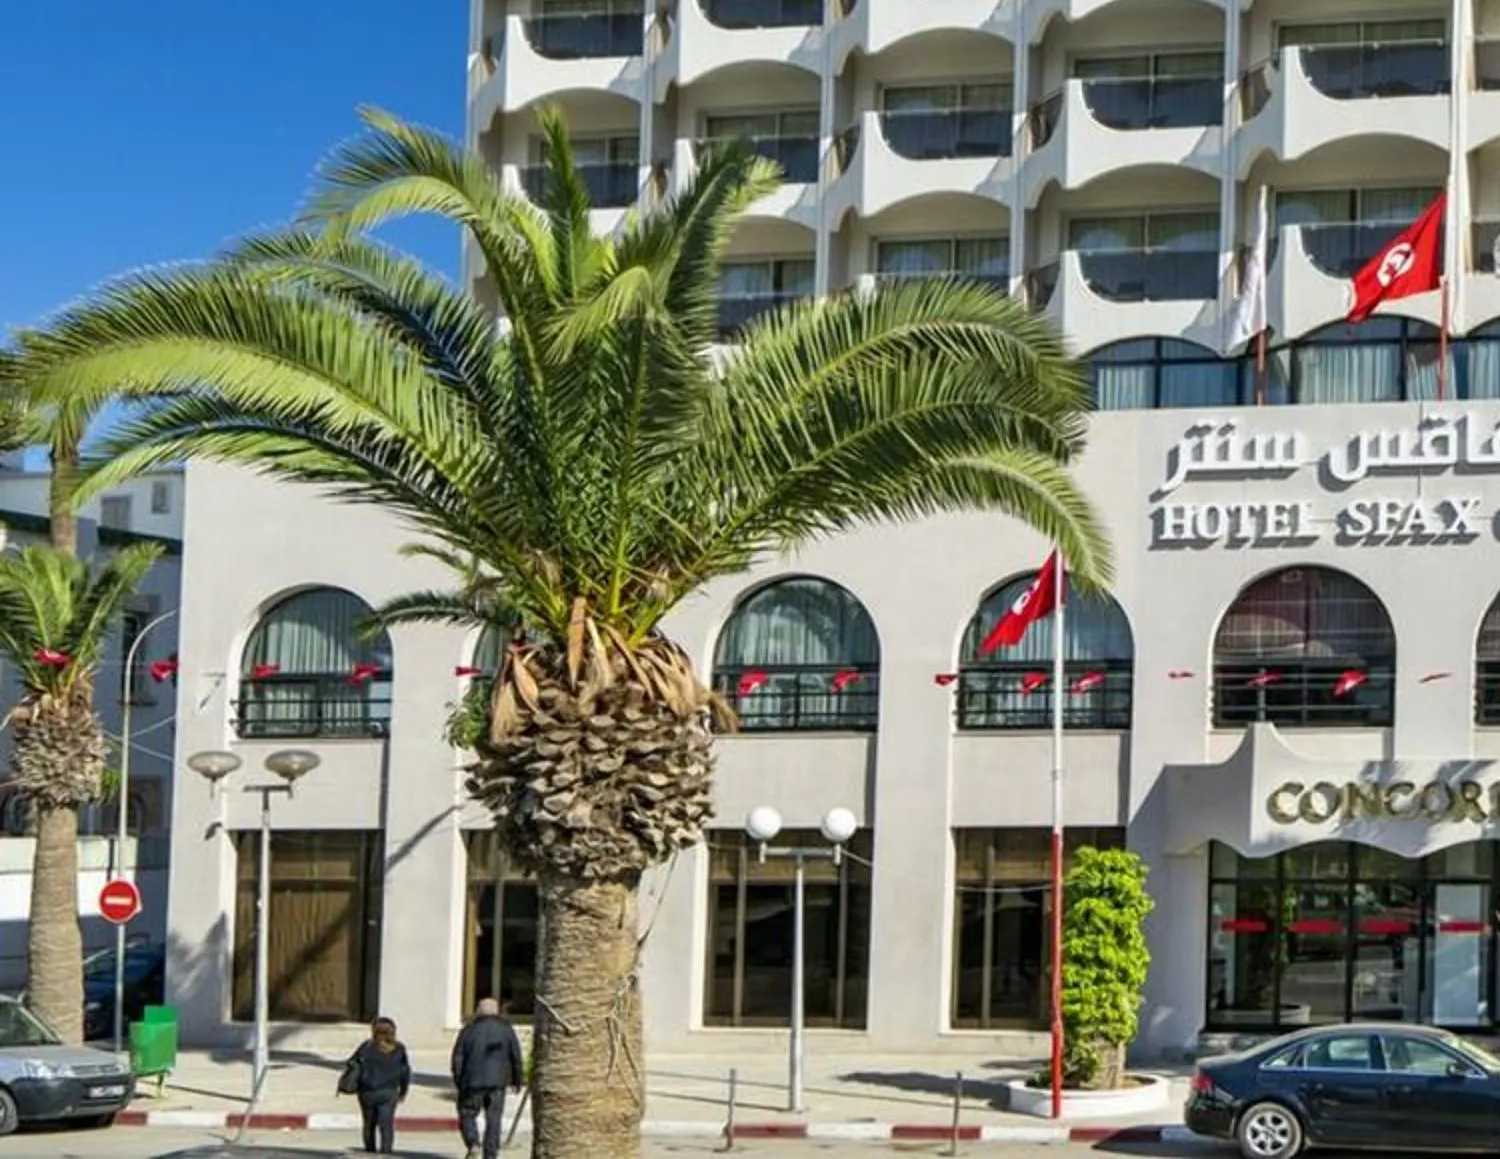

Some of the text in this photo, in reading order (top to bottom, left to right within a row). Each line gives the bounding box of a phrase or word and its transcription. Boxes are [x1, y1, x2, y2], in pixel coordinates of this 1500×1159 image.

[1155, 416, 1306, 493] سنتر
[1156, 502, 1319, 542] HOTEL
[1343, 497, 1481, 540] SFAX
